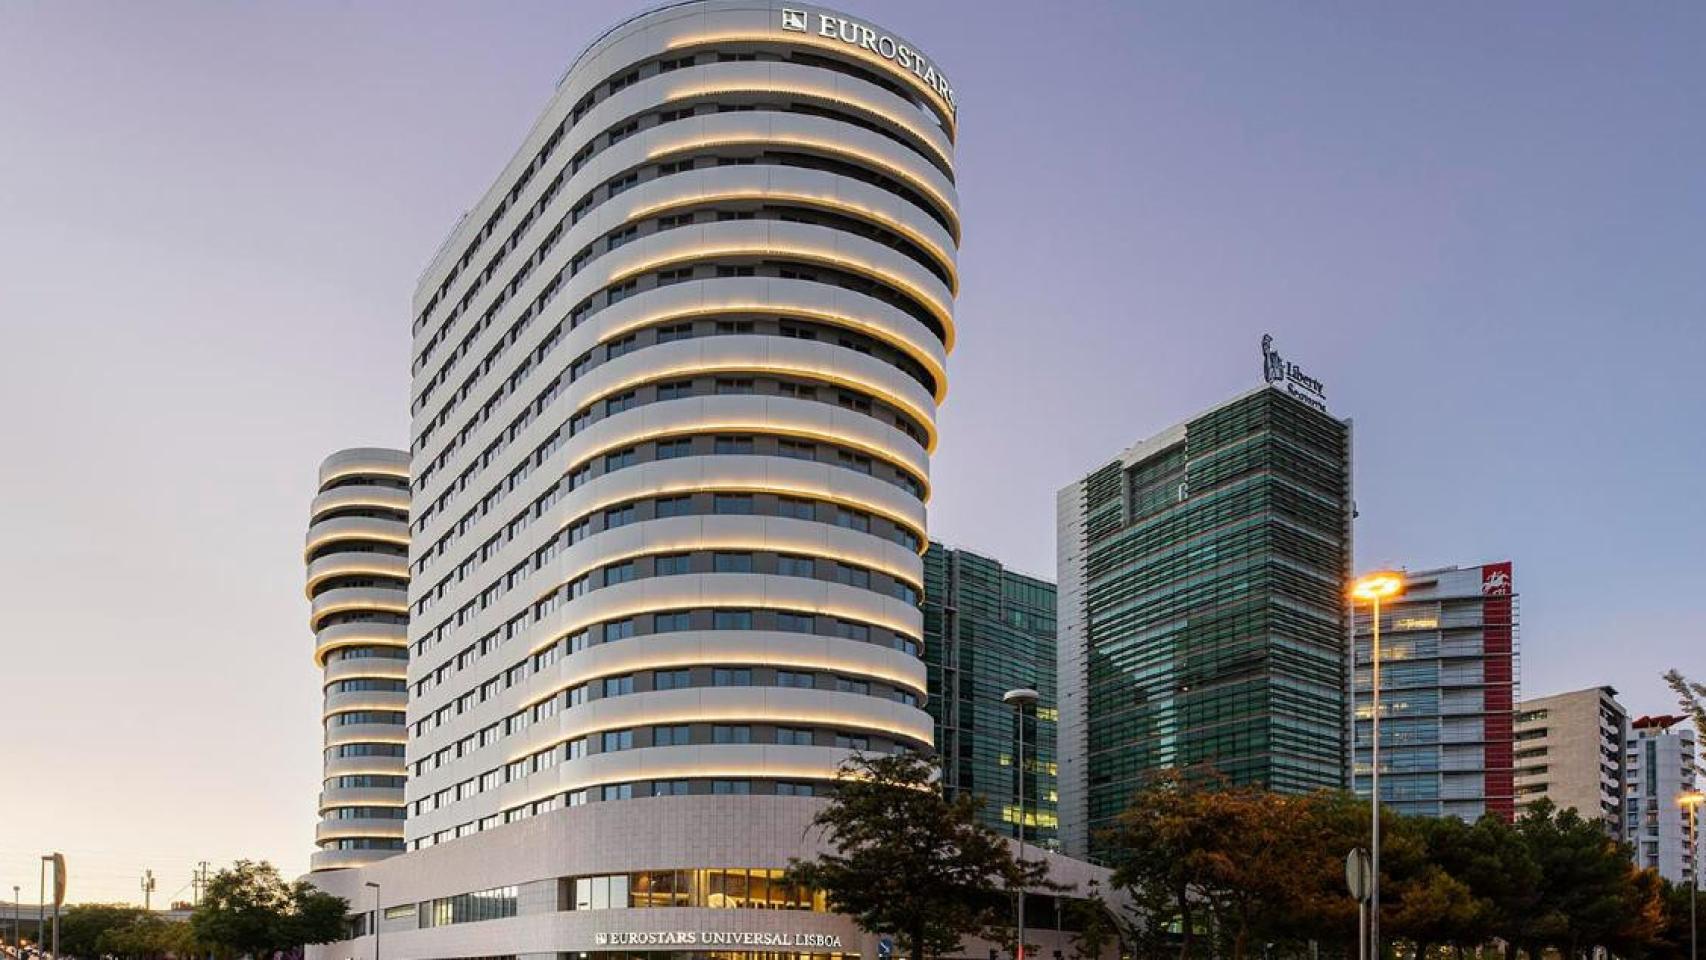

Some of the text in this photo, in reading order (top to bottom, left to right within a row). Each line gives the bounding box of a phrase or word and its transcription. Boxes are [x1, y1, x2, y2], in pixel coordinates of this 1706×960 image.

[610, 931, 842, 948] EUROSTARS UNIVERSAL LISBOA
